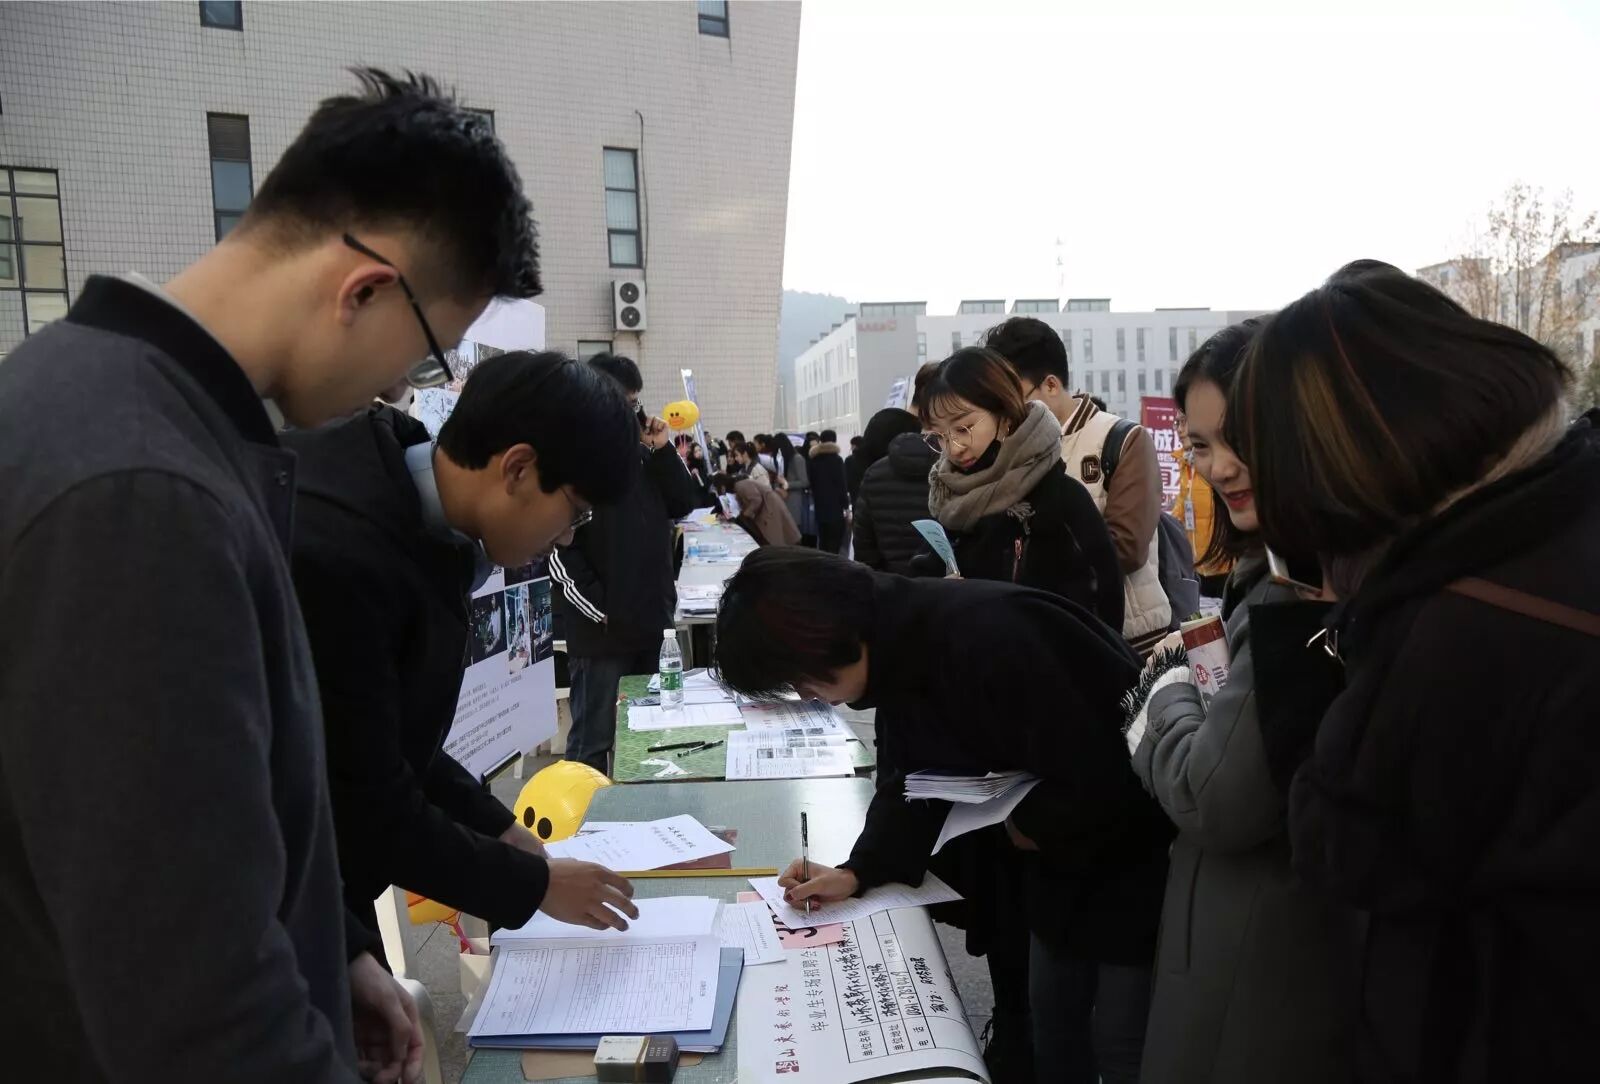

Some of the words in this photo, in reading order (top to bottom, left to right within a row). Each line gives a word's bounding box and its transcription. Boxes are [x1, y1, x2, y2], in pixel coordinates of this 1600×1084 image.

[858, 1030, 873, 1056] 单位名称
[888, 1024, 904, 1051] 单位地址
